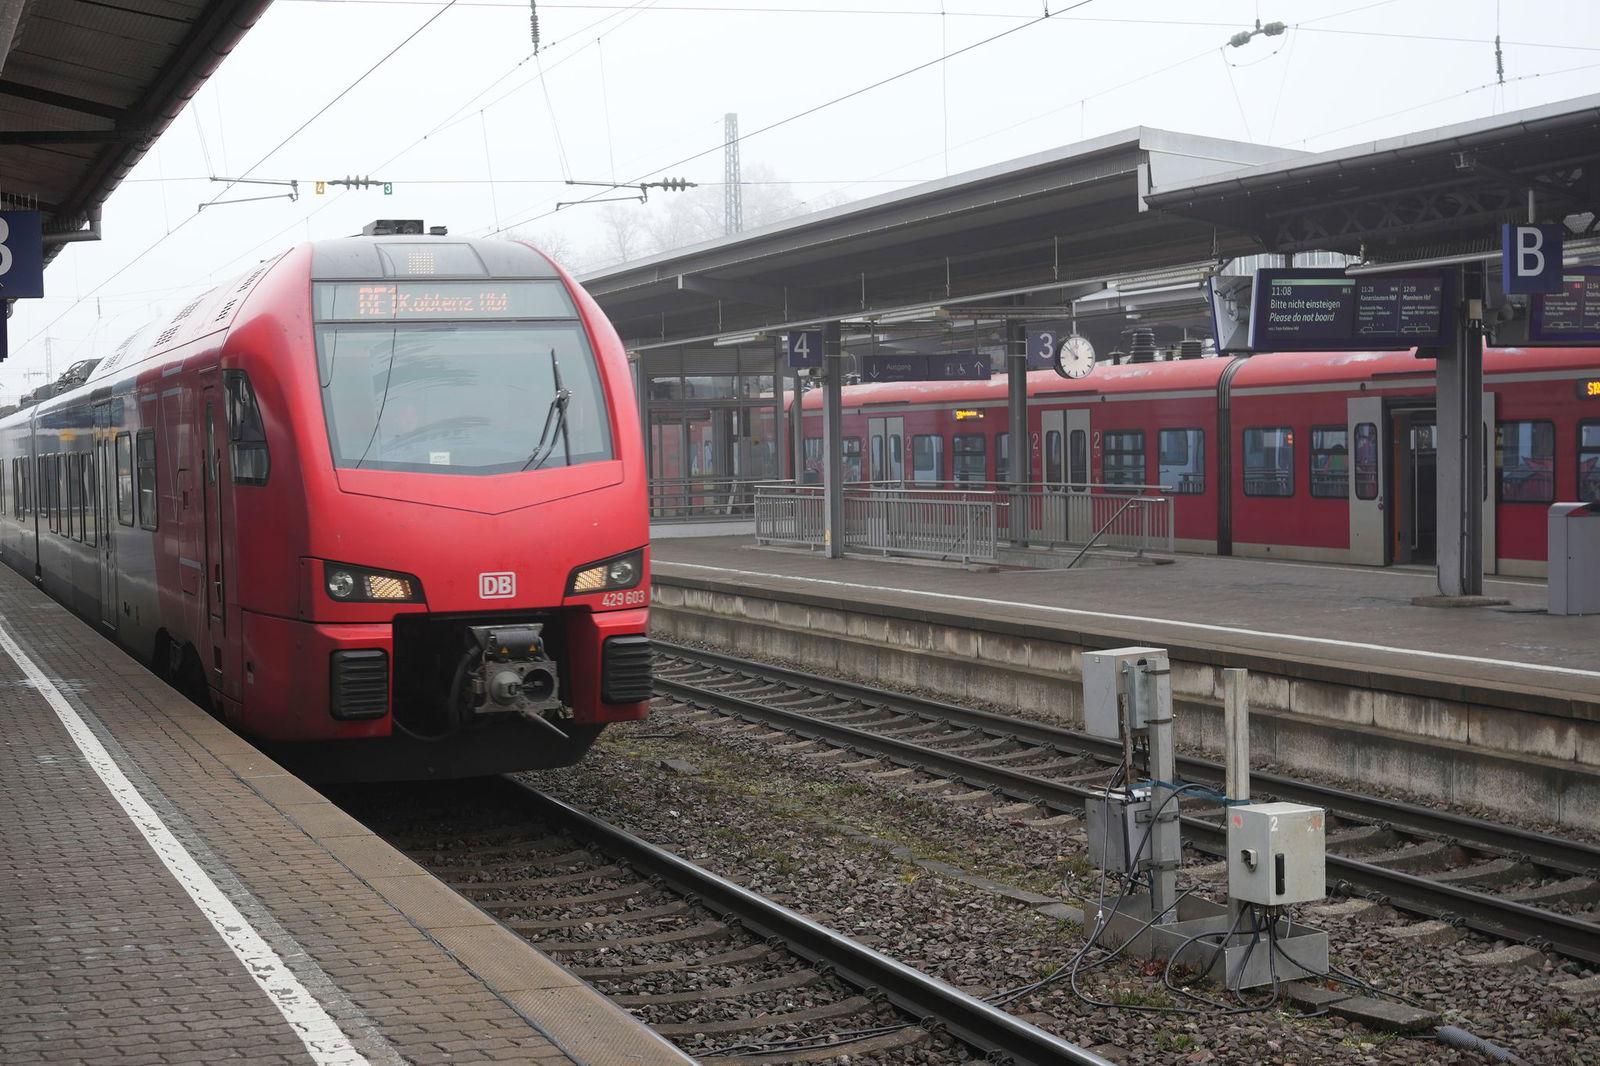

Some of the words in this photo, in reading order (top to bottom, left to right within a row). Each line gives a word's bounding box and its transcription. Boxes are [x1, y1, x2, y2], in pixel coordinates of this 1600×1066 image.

[384, 182, 392, 194] 3
[1516, 226, 1545, 277] B
[1271, 286, 1292, 296] 11:08
[399, 293, 473, 312] Koblenz
[1270, 299, 1287, 309] Bitte
[1288, 300, 1305, 309] nicht
[1306, 300, 1341, 311] einsteigen
[1269, 312, 1292, 322] Please
[1293, 312, 1301, 322] do
[1302, 313, 1314, 322] not
[1315, 312, 1335, 322] board
[793, 332, 810, 359] 4
[1039, 332, 1054, 359] 3
[1032, 433, 1039, 450] 2
[1093, 432, 1100, 449] 2
[485, 576, 512, 595] DB
[602, 592, 624, 607] 429
[626, 590, 645, 605] 603
[1270, 816, 1279, 832] 2
